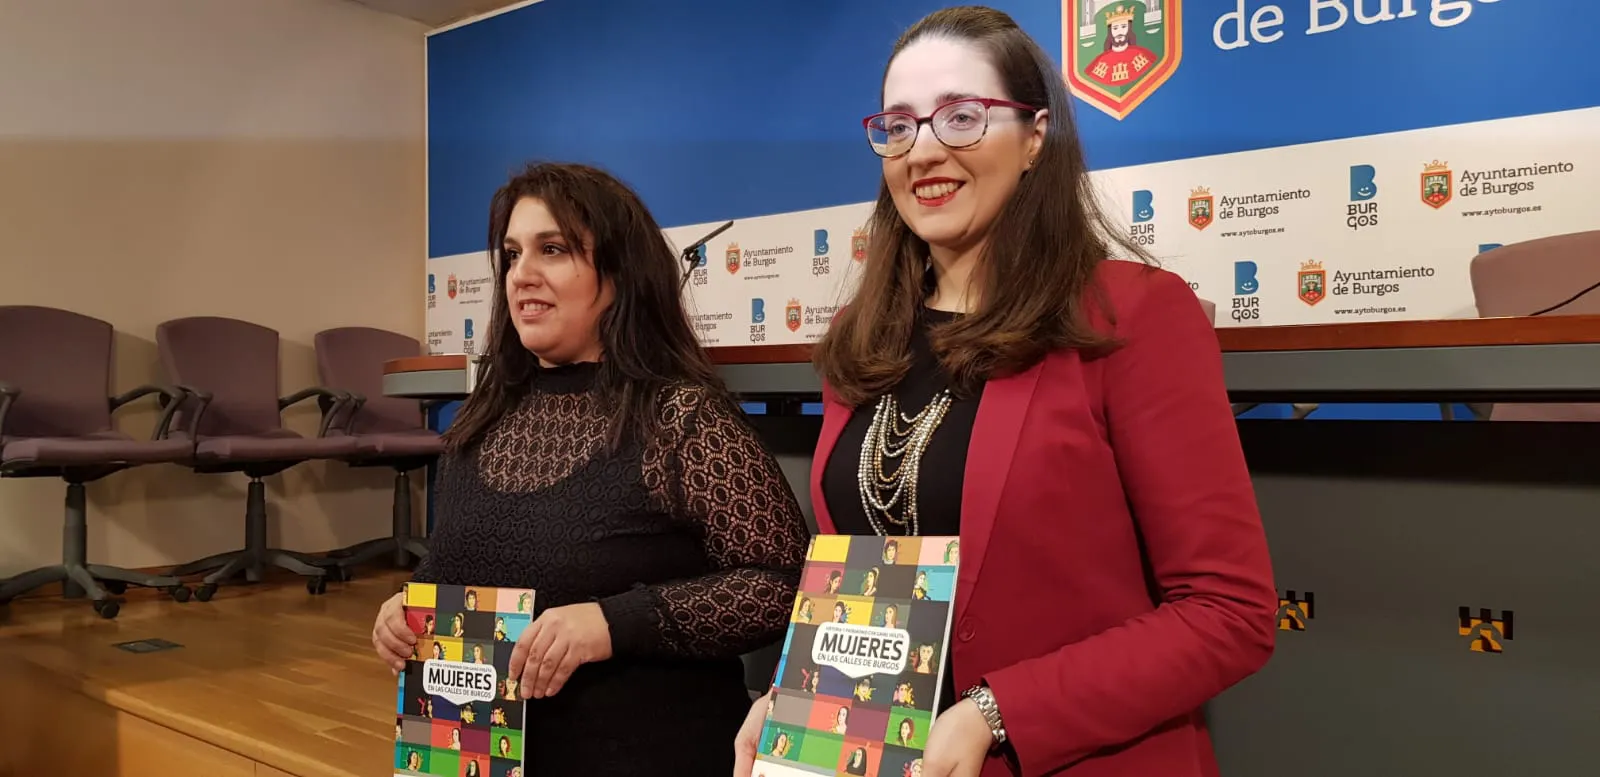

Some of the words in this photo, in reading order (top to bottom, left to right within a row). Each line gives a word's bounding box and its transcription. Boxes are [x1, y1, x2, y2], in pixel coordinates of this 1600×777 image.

[1213, 0, 1284, 50] de
[1460, 161, 1574, 185] Ayuntamiento
[1460, 184, 1477, 196] de
[1482, 181, 1534, 195] Burgos
[1220, 188, 1311, 209] Ayuntamiento
[1219, 207, 1234, 219] de
[1237, 206, 1279, 219] Burgos
[1347, 202, 1378, 215] BUR
[1462, 205, 1542, 217] www.aytoburgos.es
[1130, 224, 1155, 235] BUR
[1221, 227, 1285, 237] www.aytoburgos.es
[743, 245, 794, 259] Ayuntamiento
[743, 259, 752, 267] de
[753, 257, 777, 267] Burgos
[813, 257, 829, 266] BUR
[1333, 266, 1435, 285] Ayuntamiento
[1332, 283, 1348, 295] de
[1352, 282, 1400, 296] Burgos
[1232, 297, 1260, 308] BUR
[1334, 306, 1406, 315] www.aytoburgos.es
[750, 325, 765, 333] BUR
[820, 632, 903, 661] MUJERES
[817, 653, 826, 661] EN
[827, 654, 838, 663] LAS
[840, 655, 862, 666] CALLES
[863, 659, 872, 667] DE
[873, 659, 900, 671] BURGOS
[429, 667, 492, 690] MUJERES
